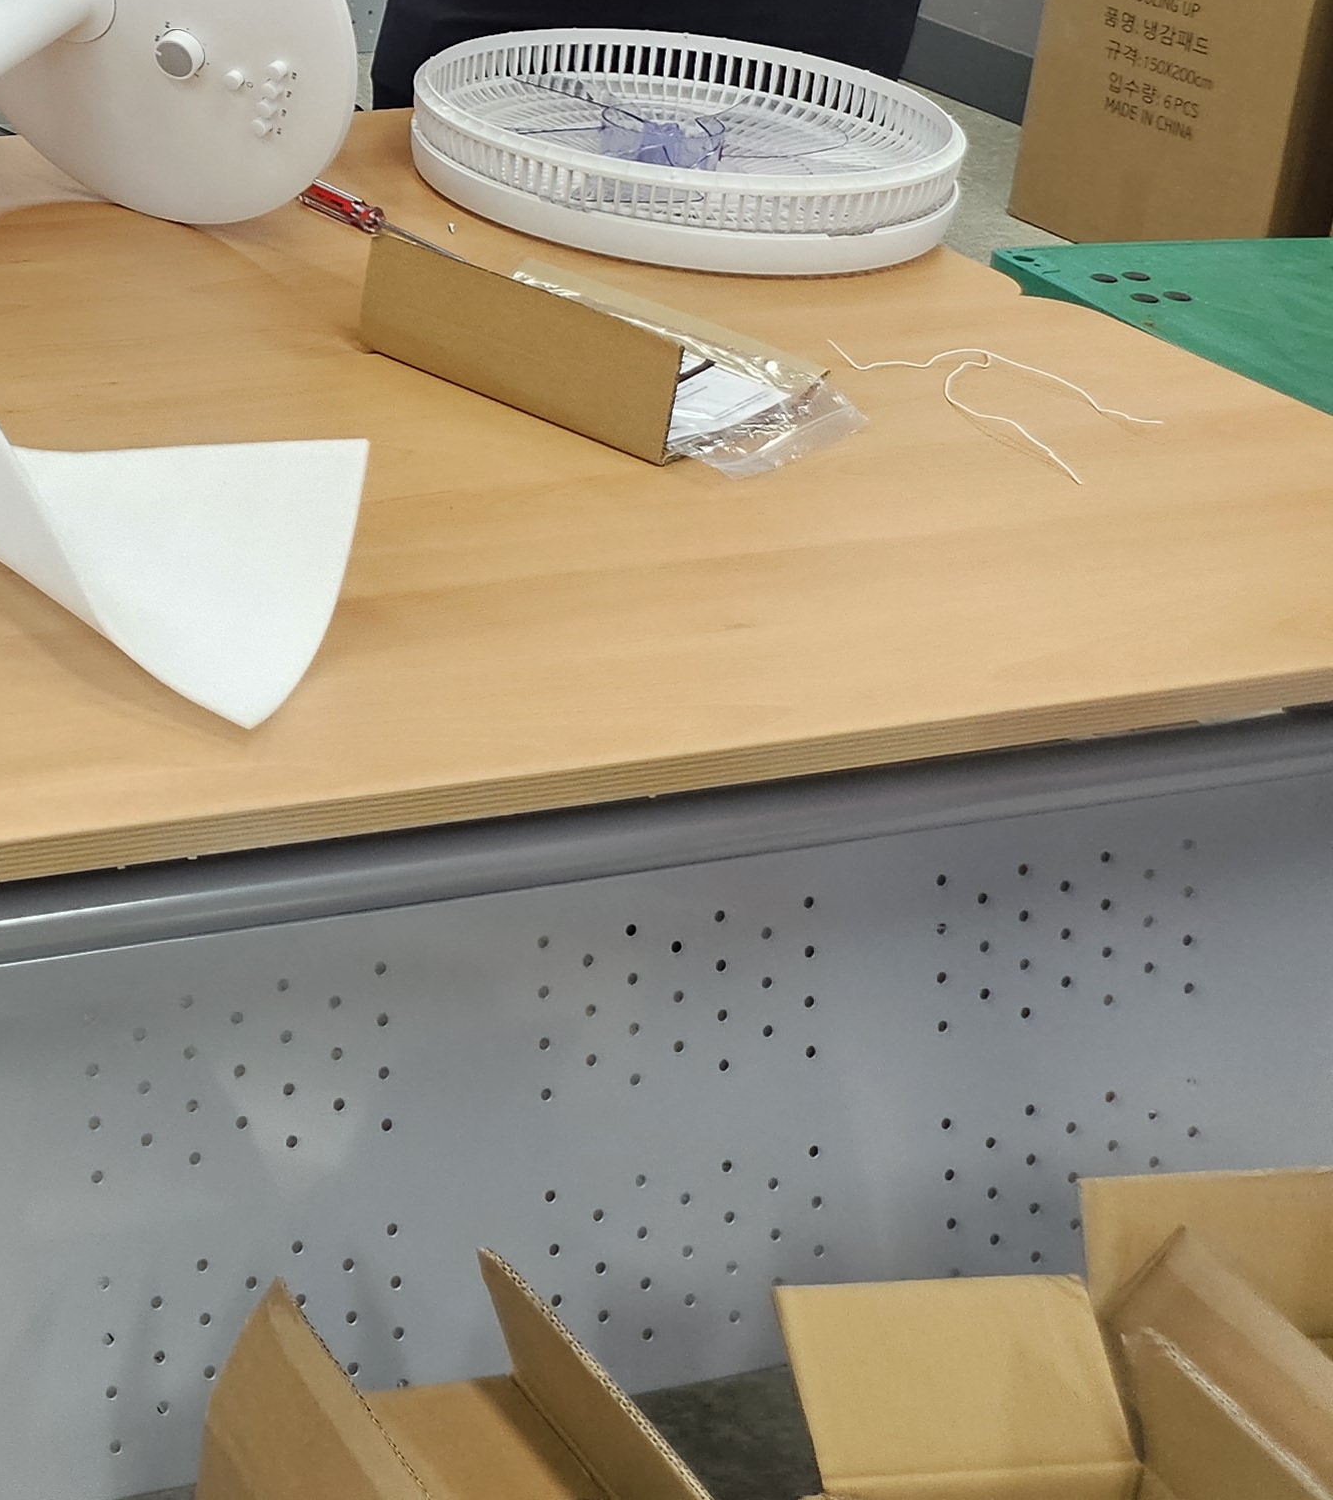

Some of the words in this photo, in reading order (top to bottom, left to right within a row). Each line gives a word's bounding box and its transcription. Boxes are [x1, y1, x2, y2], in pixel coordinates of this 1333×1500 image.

[1182, 1, 1201, 19] UP
[1143, 19, 1208, 56] 냉감패드
[1104, 96, 1139, 121] MADE
[1140, 108, 1153, 126] IN
[1156, 114, 1193, 141] CHINA
